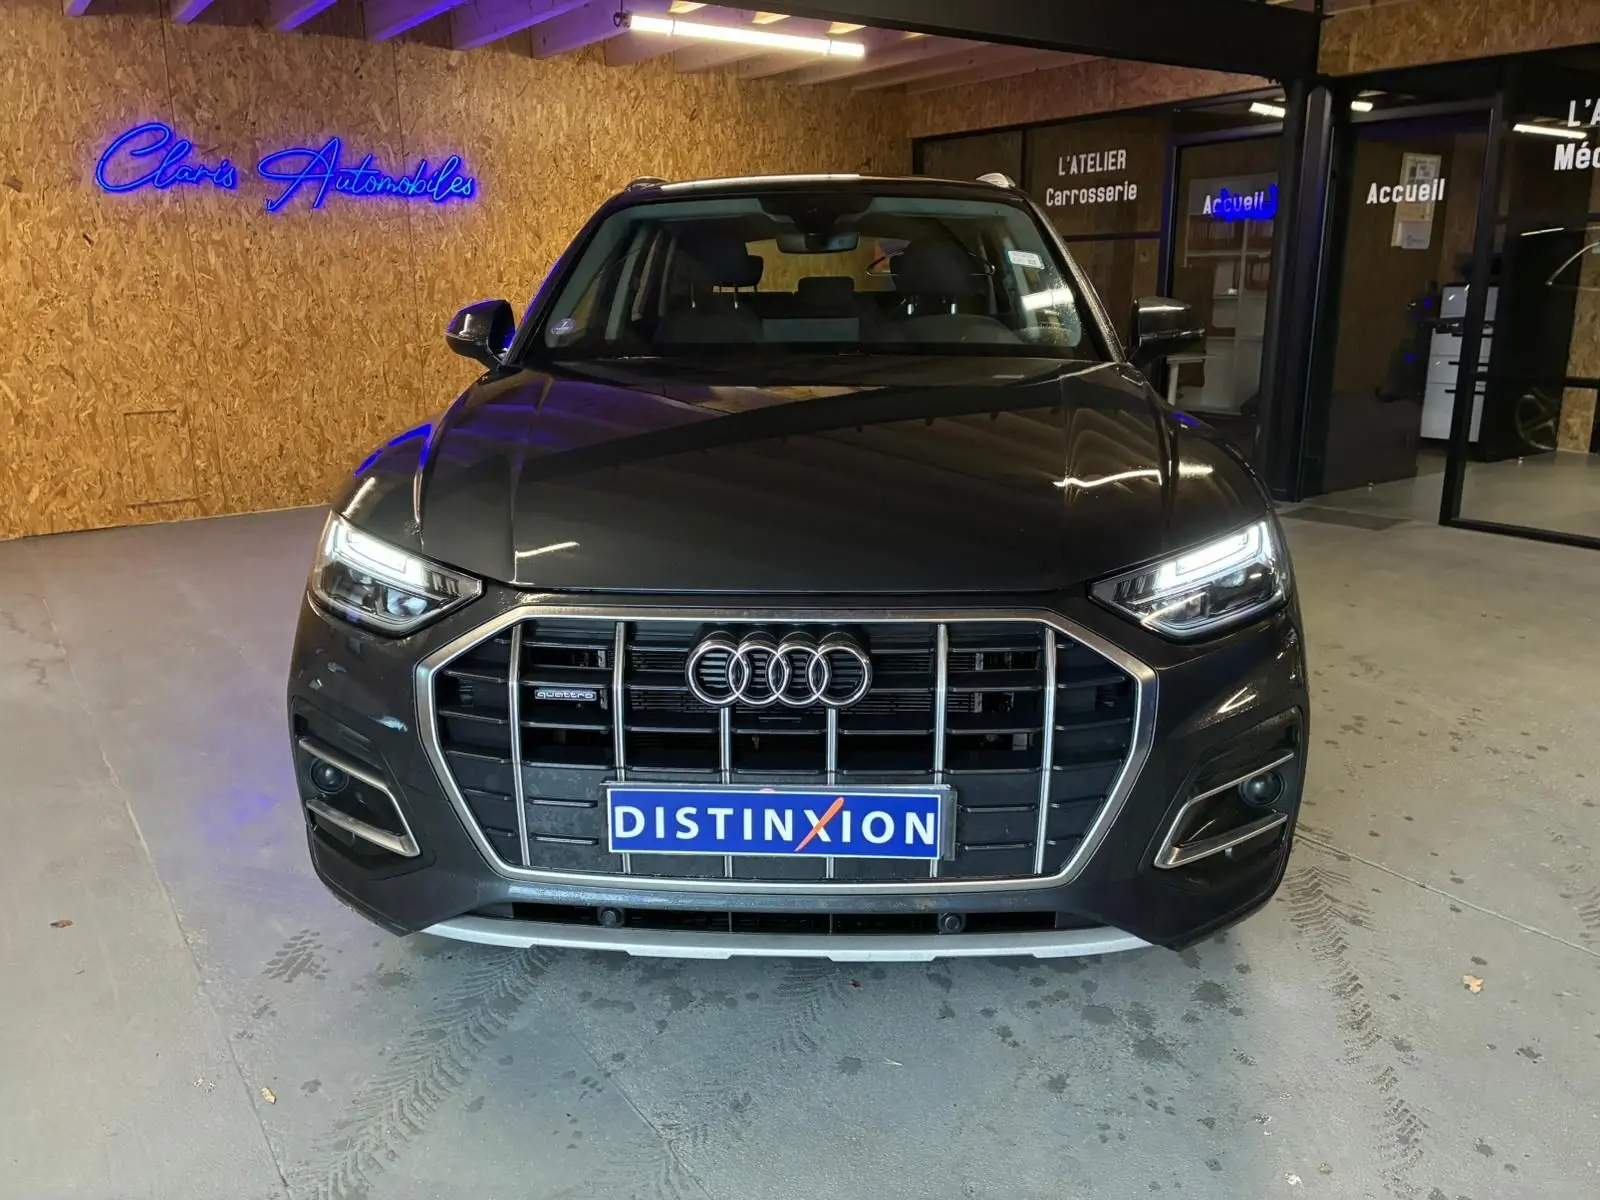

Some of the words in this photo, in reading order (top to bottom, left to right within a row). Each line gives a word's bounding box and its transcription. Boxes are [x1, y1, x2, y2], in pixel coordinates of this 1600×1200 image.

[95, 122, 237, 193] Claris
[256, 136, 475, 212] Automobiles
[1058, 149, 1127, 177] L'ATELIER
[1045, 181, 1138, 207] Carrosserie
[1202, 191, 1265, 215] Accueil
[1366, 178, 1446, 204] Accueil
[536, 690, 595, 700] quattro
[612, 796, 936, 852] DISTINXION
